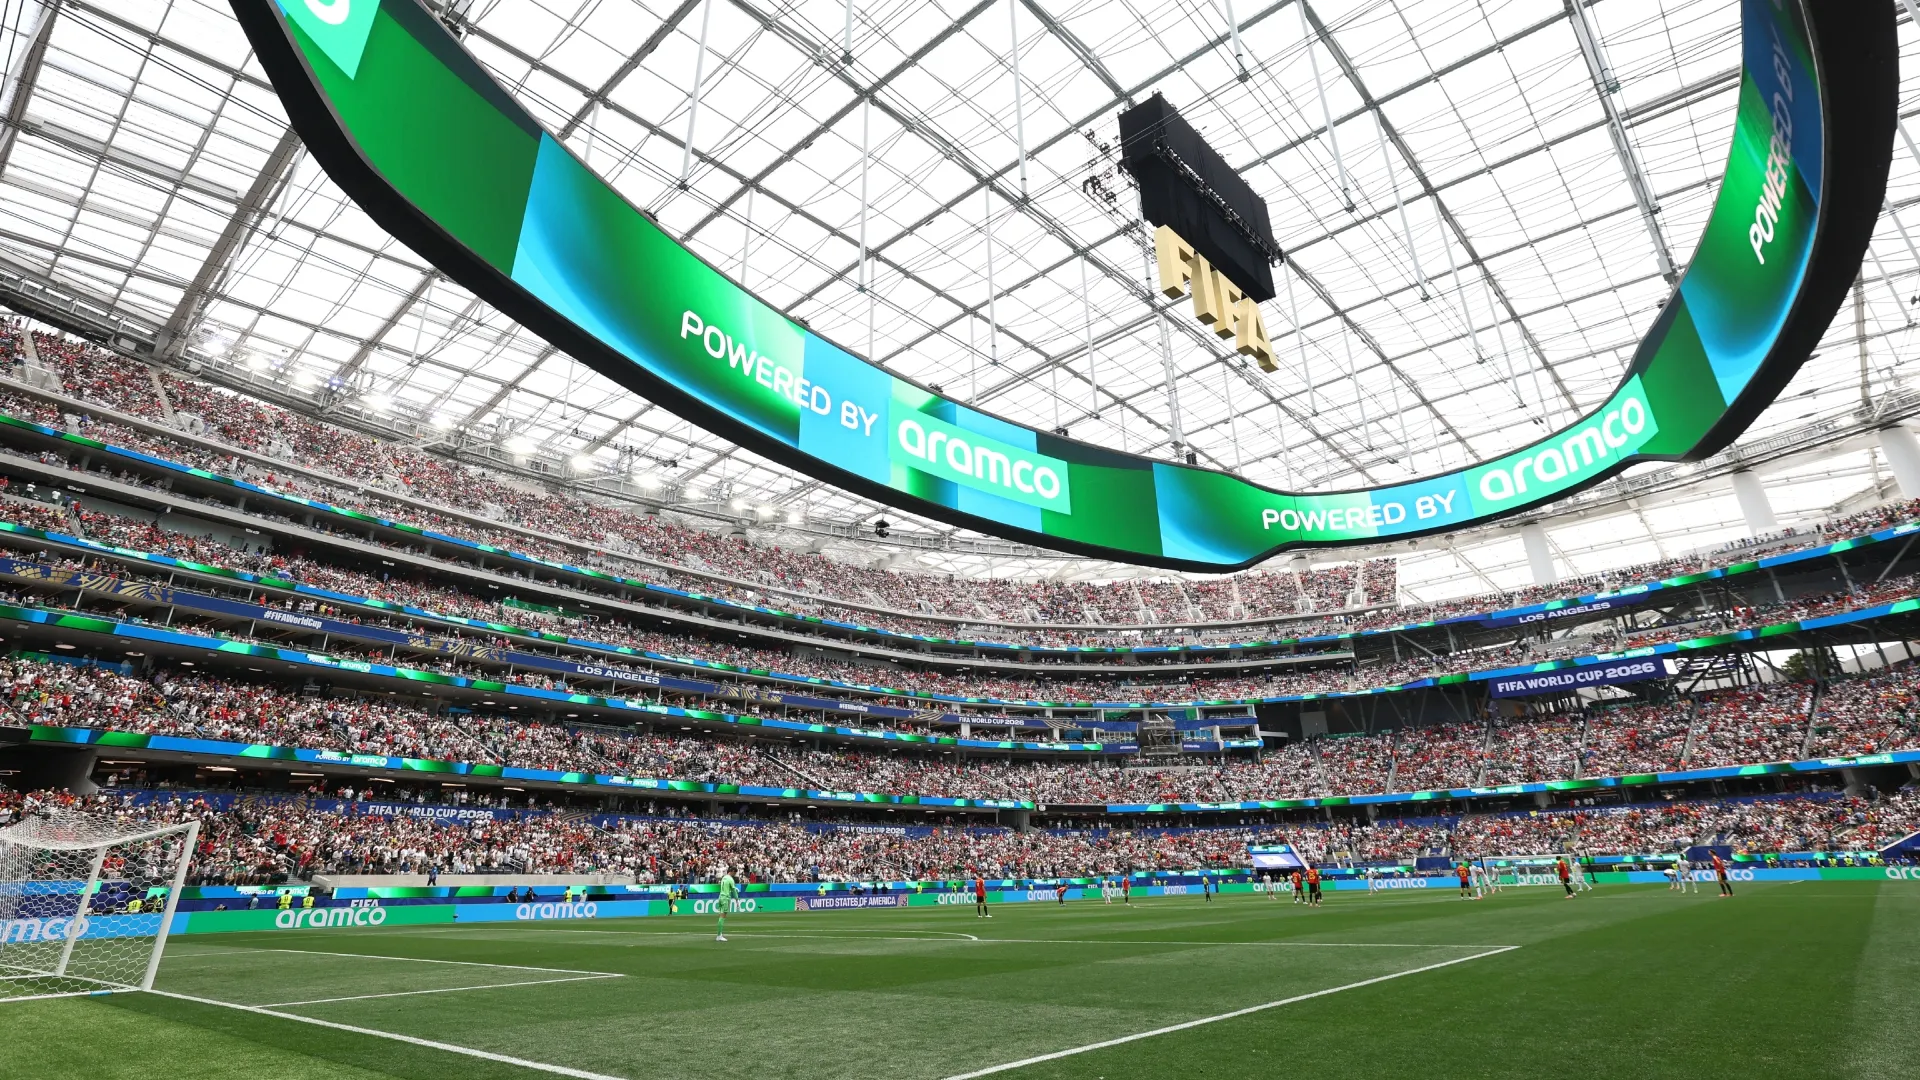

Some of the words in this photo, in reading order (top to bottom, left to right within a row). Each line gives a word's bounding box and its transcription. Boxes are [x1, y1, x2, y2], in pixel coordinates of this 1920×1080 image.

[1770, 22, 1793, 102] BY
[1749, 92, 1793, 265] POWERED
[1153, 225, 1279, 374] FIFA
[680, 310, 831, 415] POWERED
[840, 400, 878, 437] BY
[897, 419, 1060, 499] aramco
[1262, 502, 1406, 531] POWERED
[1416, 489, 1456, 519] BY
[1479, 397, 1645, 500] aramco
[264, 610, 323, 630] #FIFAWorldCup
[1519, 613, 1545, 623] LOS
[1548, 602, 1611, 618] ANGELES
[577, 665, 602, 675] LOS
[604, 670, 660, 684] ANGELES
[1497, 680, 1526, 693] FIFA
[1526, 674, 1575, 689] WORLD
[1576, 670, 1604, 683] CUP
[1605, 662, 1656, 679] 2026
[368, 804, 393, 815] FIFA
[395, 806, 435, 817] WRLD
[435, 808, 457, 818] CUP
[457, 810, 494, 820] 2026
[885, 827, 906, 835] 2026
[1163, 885, 1187, 895] aramco
[1375, 878, 1427, 889] aramco
[350, 899, 379, 908] FIFA
[515, 902, 597, 919] aramco
[810, 898, 834, 908] UNITED
[835, 897, 858, 907] STATES
[859, 897, 867, 907] OF
[868, 896, 896, 906] AMERICA
[275, 907, 387, 928] aramco
